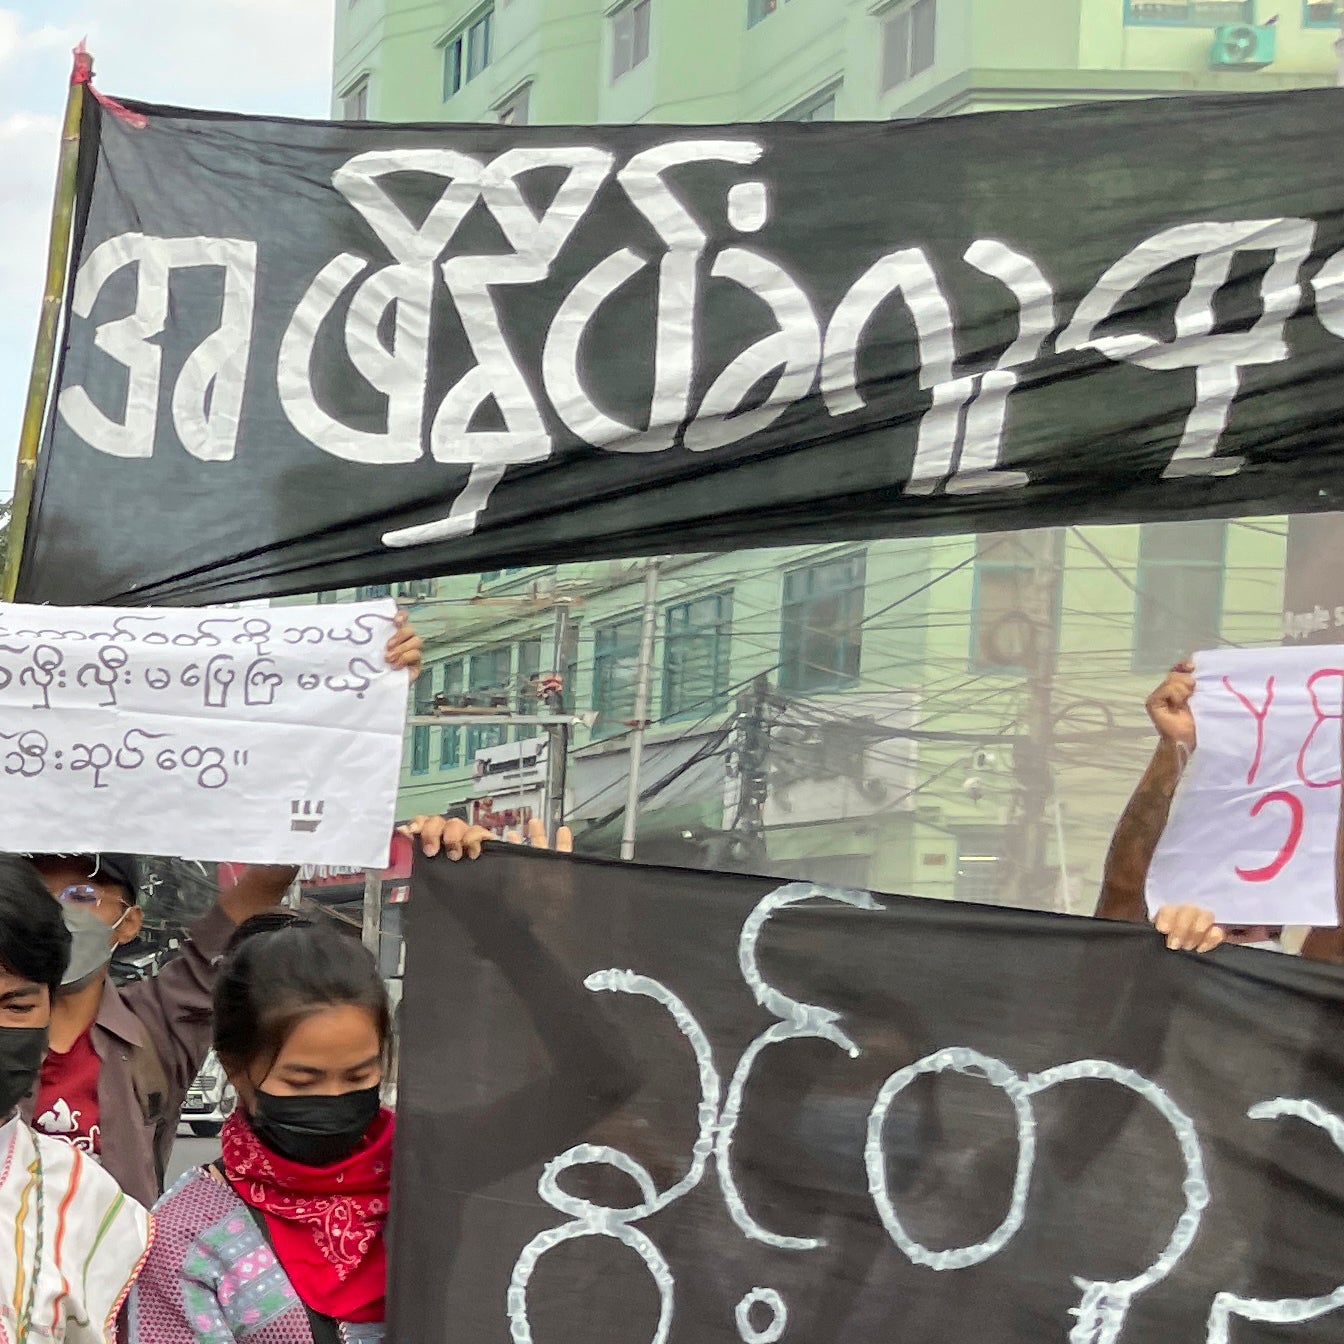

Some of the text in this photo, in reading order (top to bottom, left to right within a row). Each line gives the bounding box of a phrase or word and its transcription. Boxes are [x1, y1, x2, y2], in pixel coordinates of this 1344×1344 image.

[58, 140, 1344, 548] အဖိနှိပ်ခံလူထု
